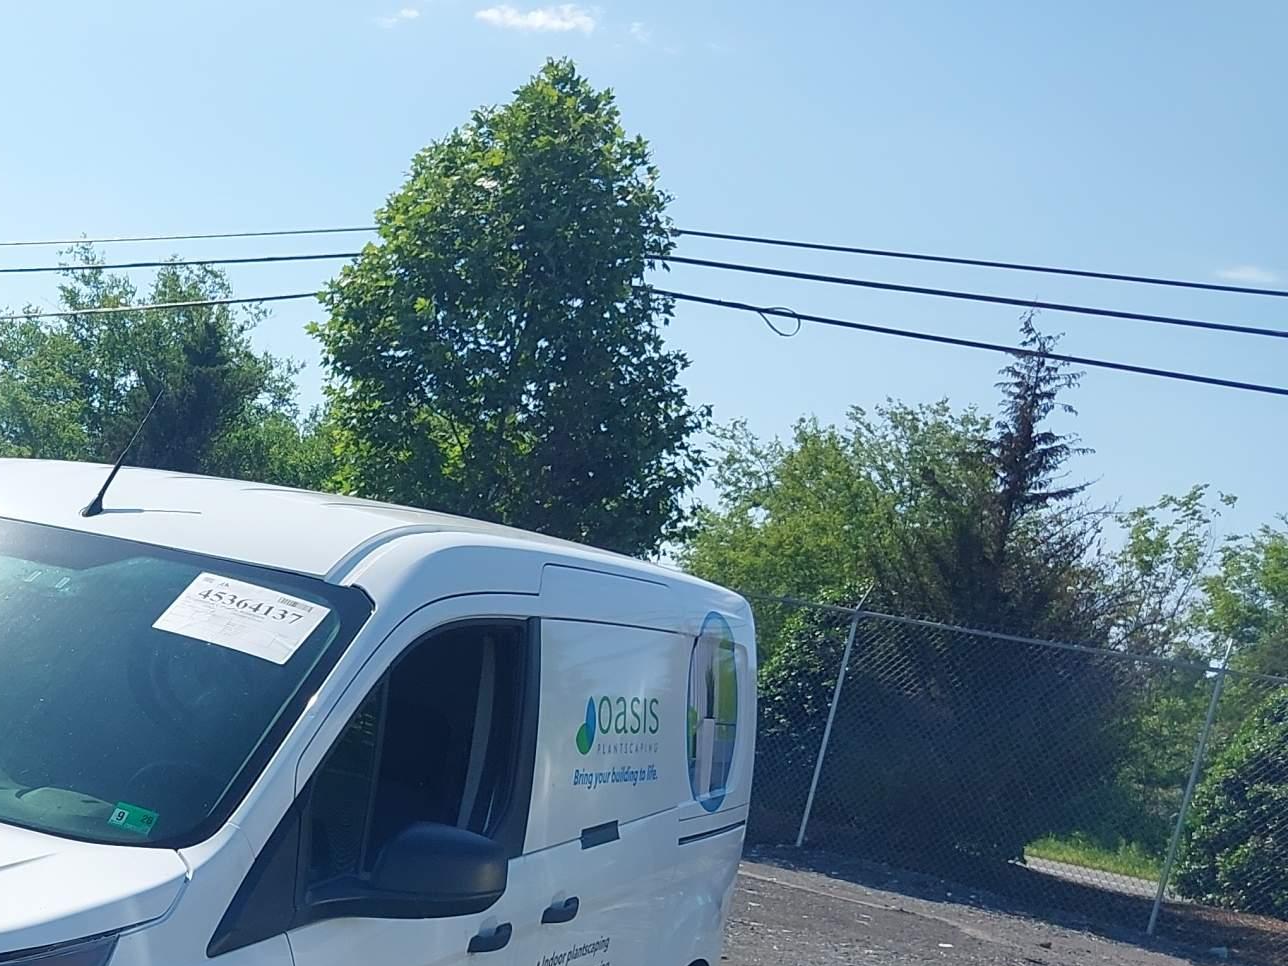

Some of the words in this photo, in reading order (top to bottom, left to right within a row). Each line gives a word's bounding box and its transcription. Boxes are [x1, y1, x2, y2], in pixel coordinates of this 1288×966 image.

[198, 588, 304, 625] 45364137
[598, 695, 659, 735] oasis
[596, 743, 659, 755] PLANTSCAPING
[573, 768, 594, 789] Bring
[593, 771, 611, 789] your
[611, 766, 639, 787] building
[638, 768, 646, 782] to
[646, 764, 658, 782] life.
[115, 810, 126, 822] 9
[566, 936, 610, 966] plantscaping
